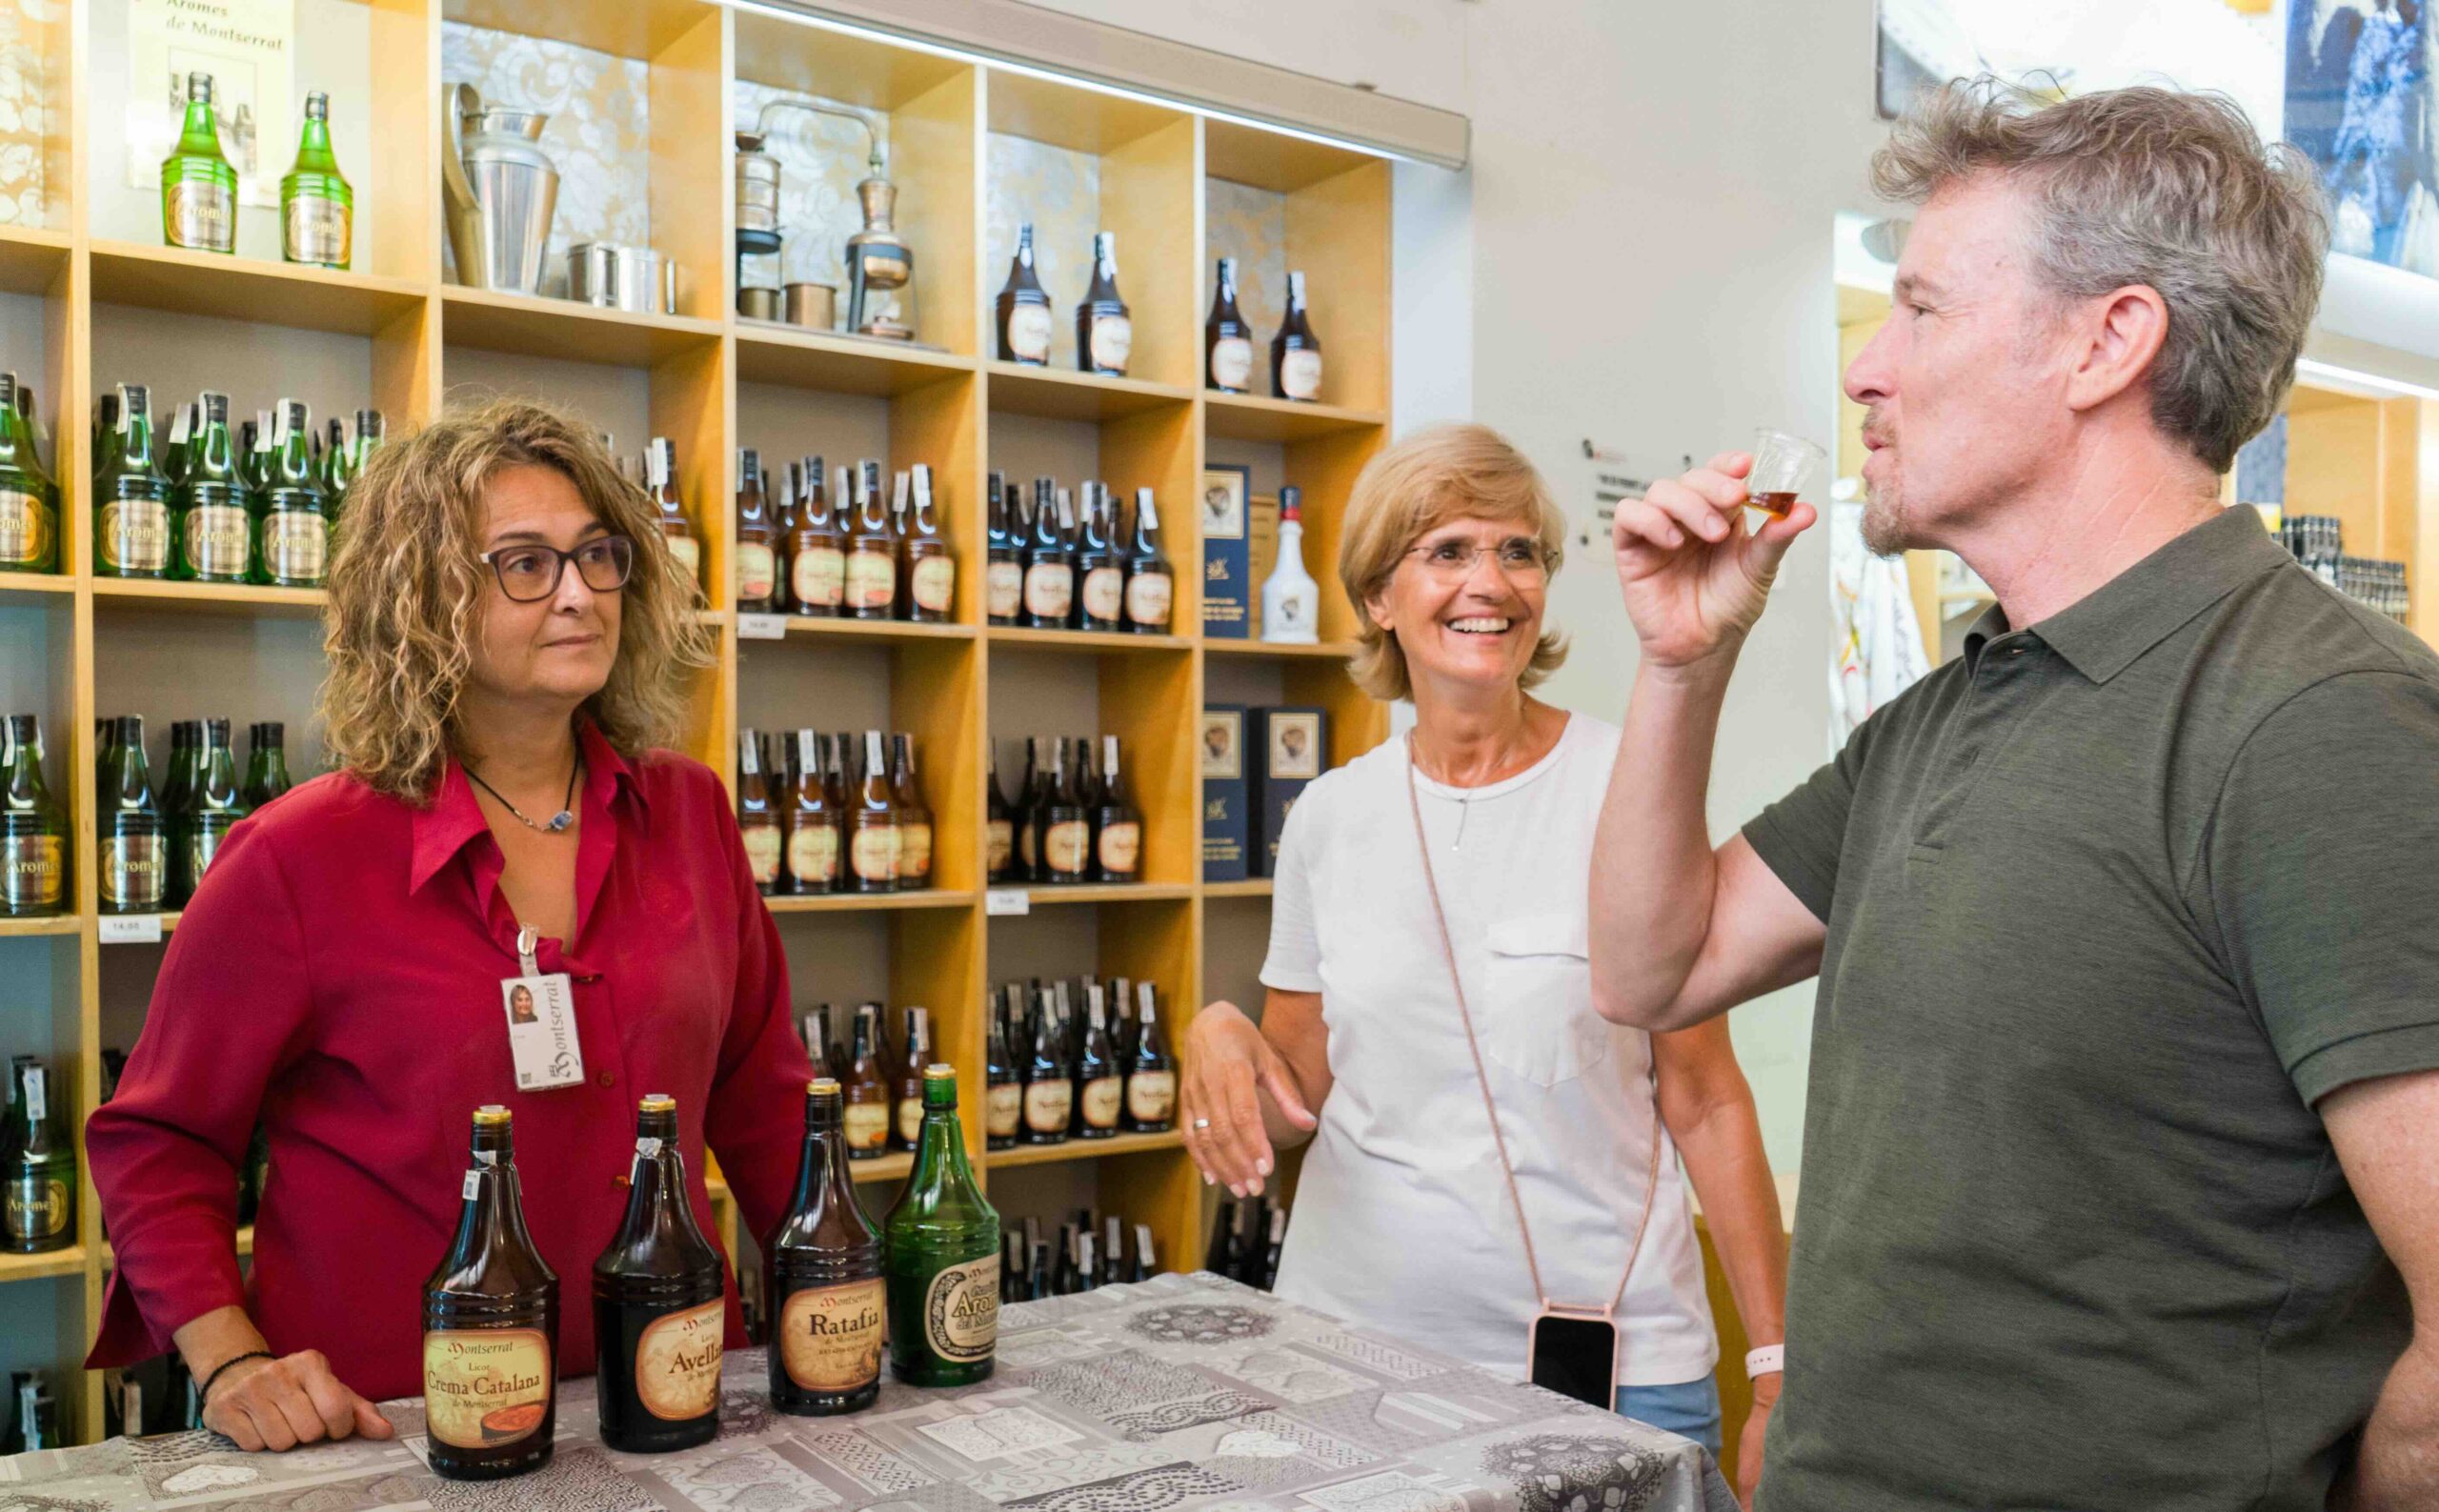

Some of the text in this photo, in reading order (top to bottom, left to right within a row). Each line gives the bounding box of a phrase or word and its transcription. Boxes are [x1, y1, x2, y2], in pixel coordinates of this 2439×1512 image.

[167, 15, 282, 50] de Montserrat
[448, 1341, 514, 1361] Montserrat
[468, 1362, 490, 1372] Licor
[427, 1371, 541, 1396] Crema Catalana
